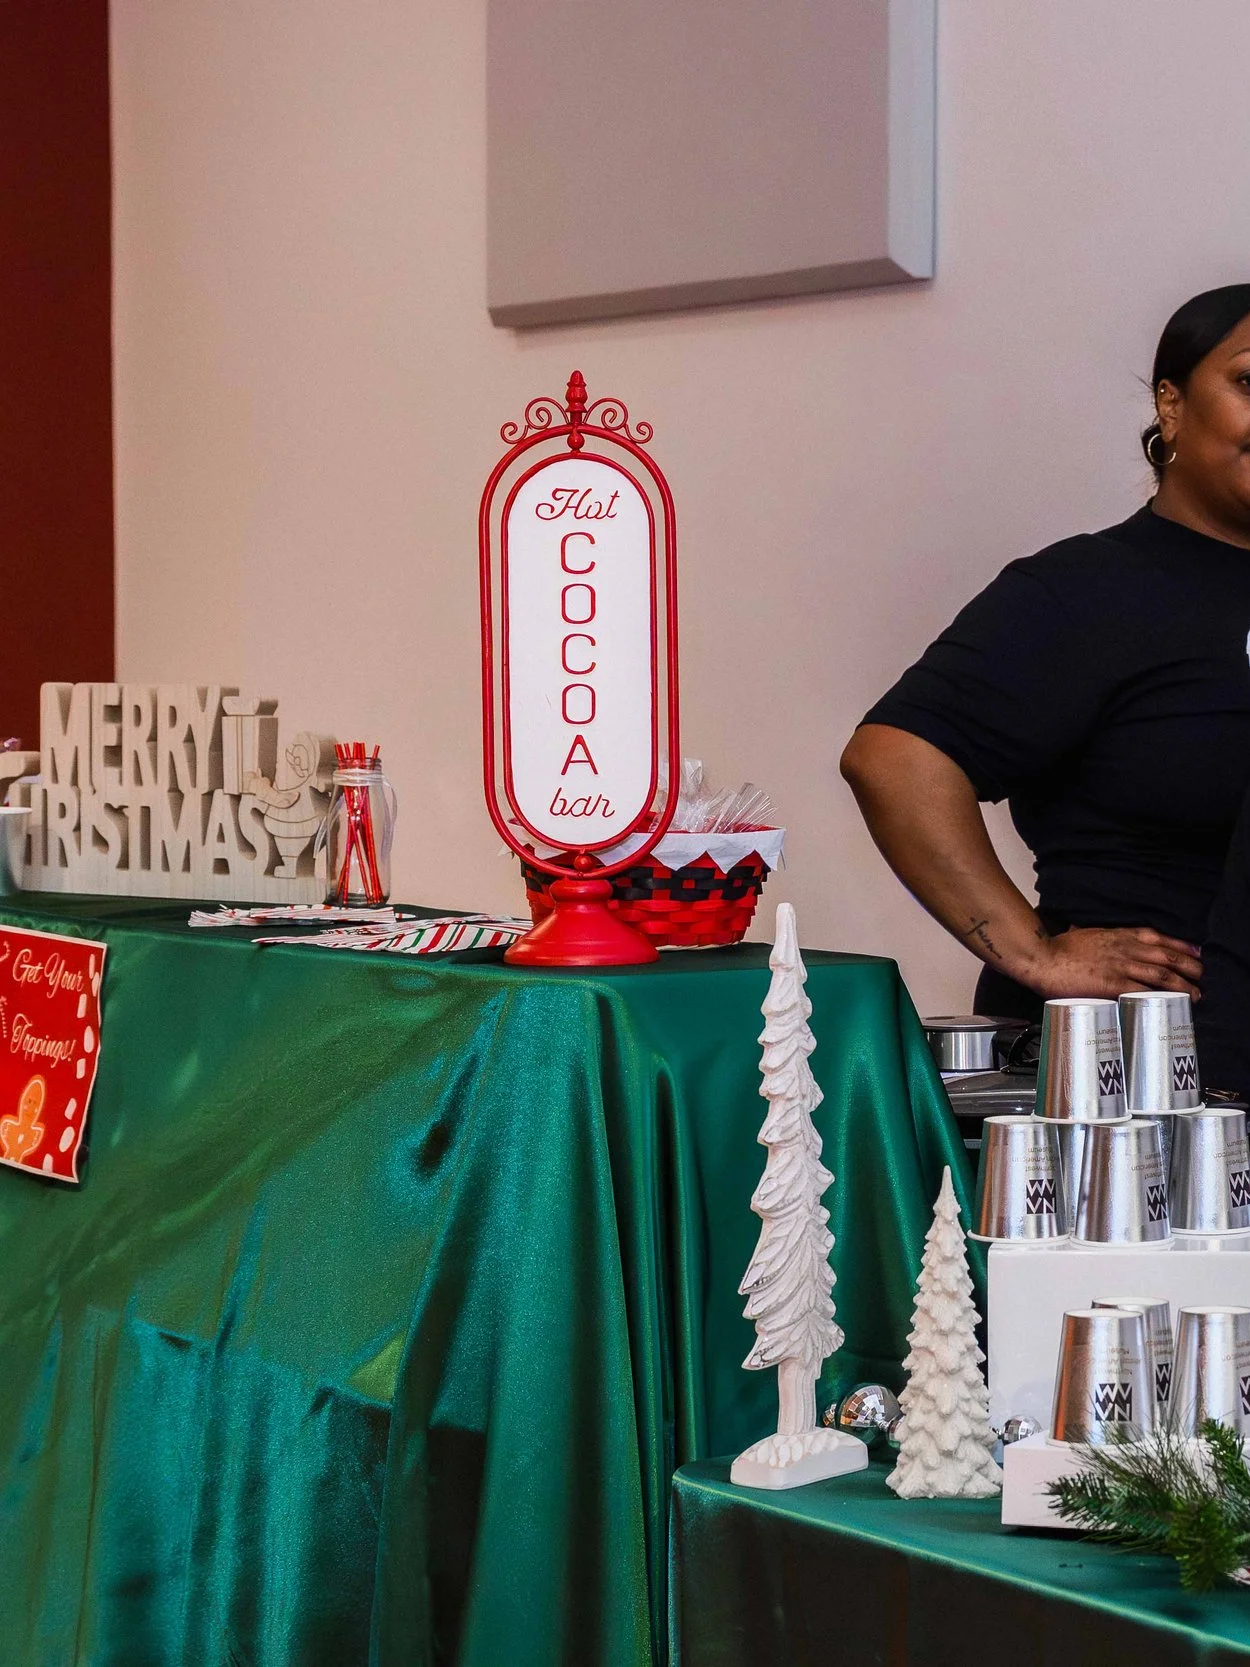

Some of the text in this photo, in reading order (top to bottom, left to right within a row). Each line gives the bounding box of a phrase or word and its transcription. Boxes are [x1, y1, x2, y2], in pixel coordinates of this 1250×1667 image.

[535, 487, 621, 521] Hot
[559, 531, 600, 777] COCOA
[40, 681, 224, 793] MERRY
[6, 779, 271, 878] HRISTMAS
[549, 786, 616, 819] bar
[12, 948, 84, 999] Get Your
[10, 1013, 77, 1069] Toppings!
